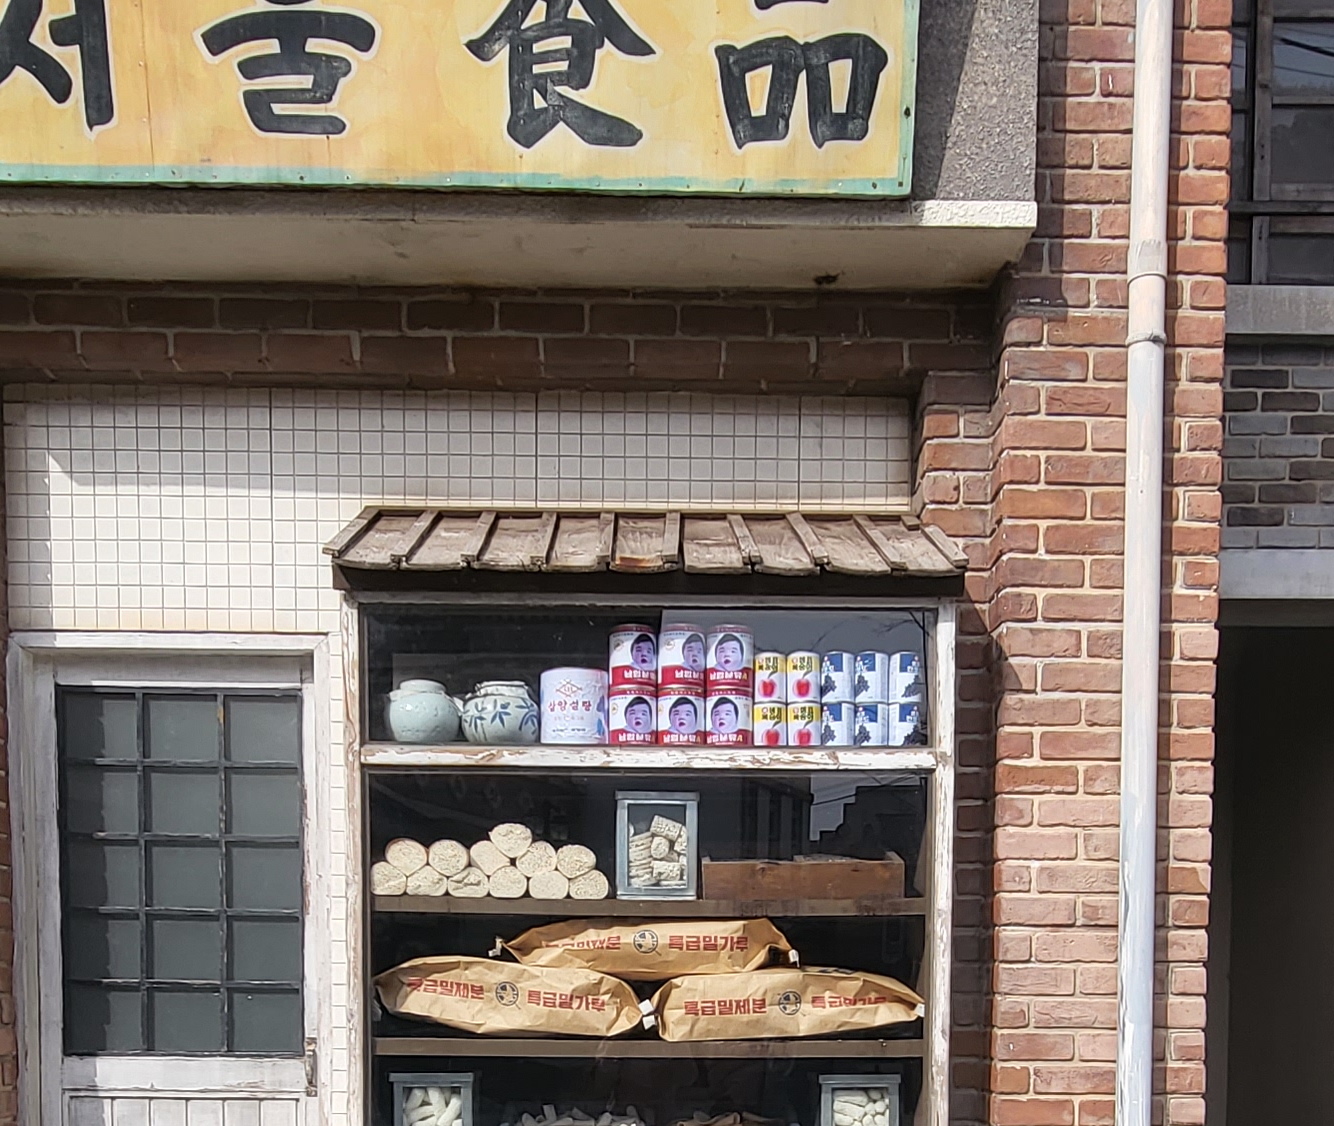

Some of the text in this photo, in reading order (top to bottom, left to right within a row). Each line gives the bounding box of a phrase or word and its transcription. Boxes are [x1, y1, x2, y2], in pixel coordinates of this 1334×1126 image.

[668, 934, 749, 952] 특급밀가루
[527, 989, 606, 1013] 특급밀가루
[683, 997, 767, 1017] 특급밀제분
